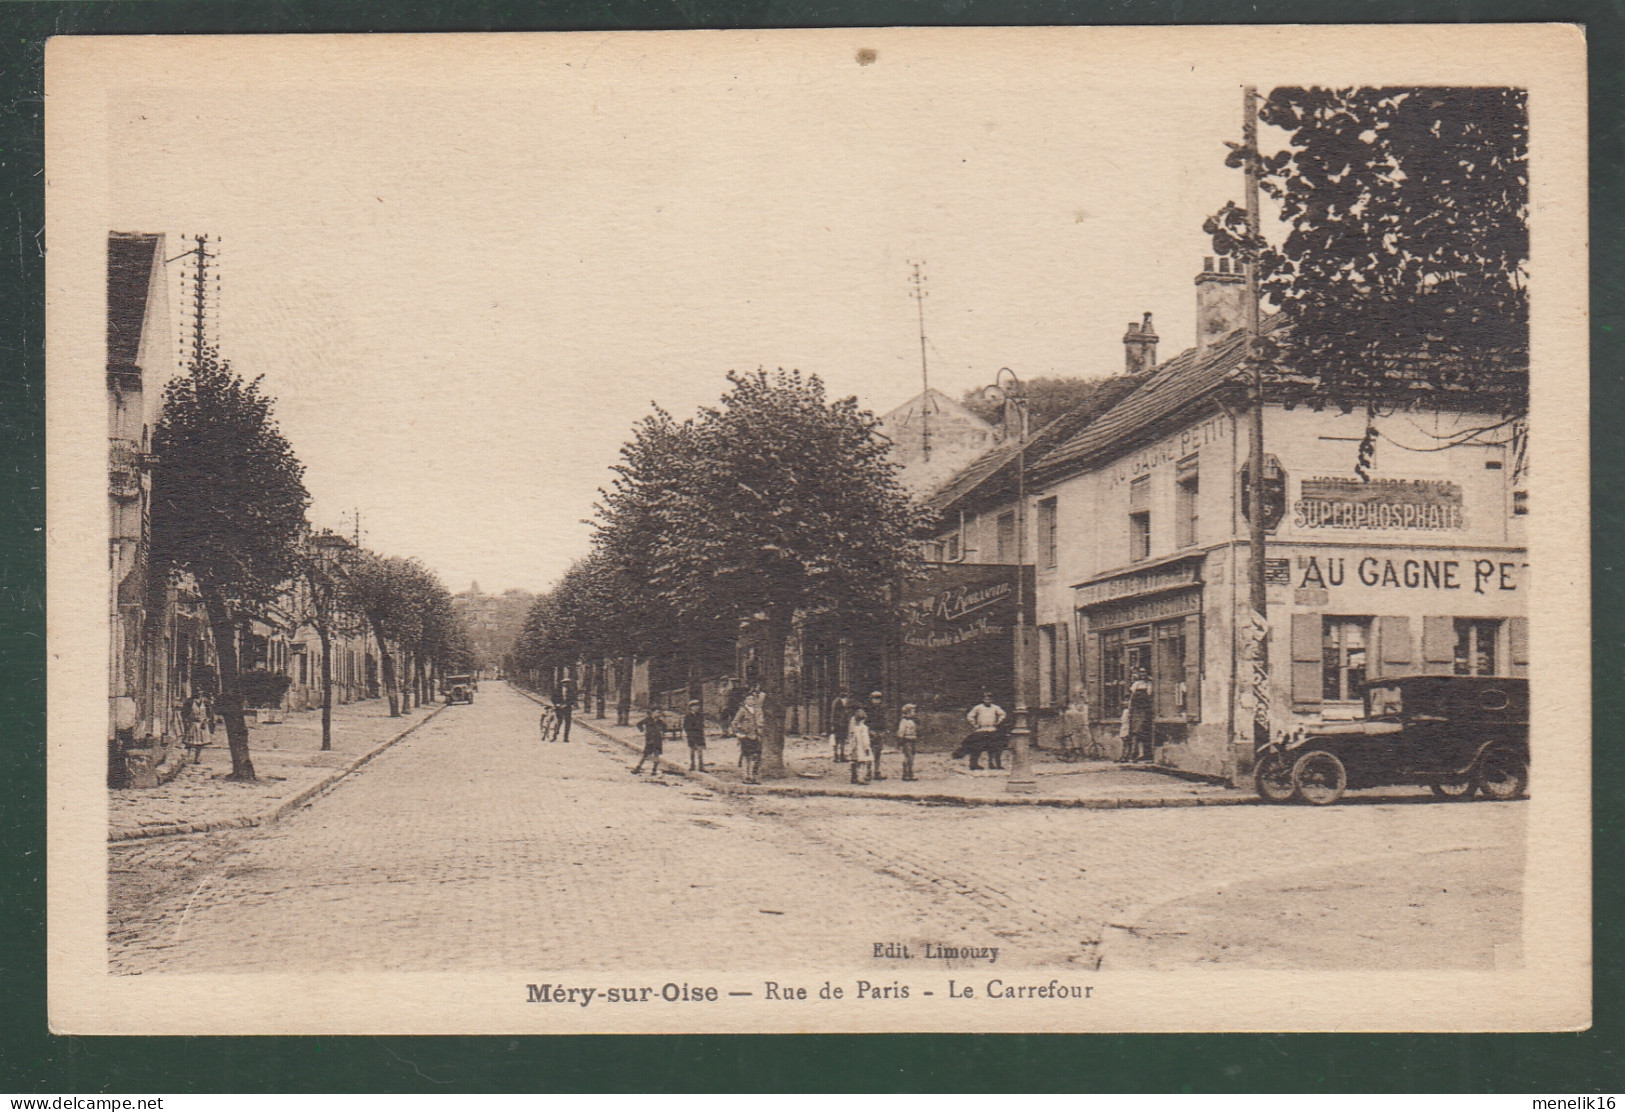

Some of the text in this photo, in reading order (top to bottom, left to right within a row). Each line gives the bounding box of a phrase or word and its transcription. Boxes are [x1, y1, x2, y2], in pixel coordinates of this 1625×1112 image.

[1181, 414, 1226, 456] PETIT
[1299, 556, 1345, 589] AU
[1358, 557, 1461, 590] GAGNE
[1474, 559, 1530, 595] PE
